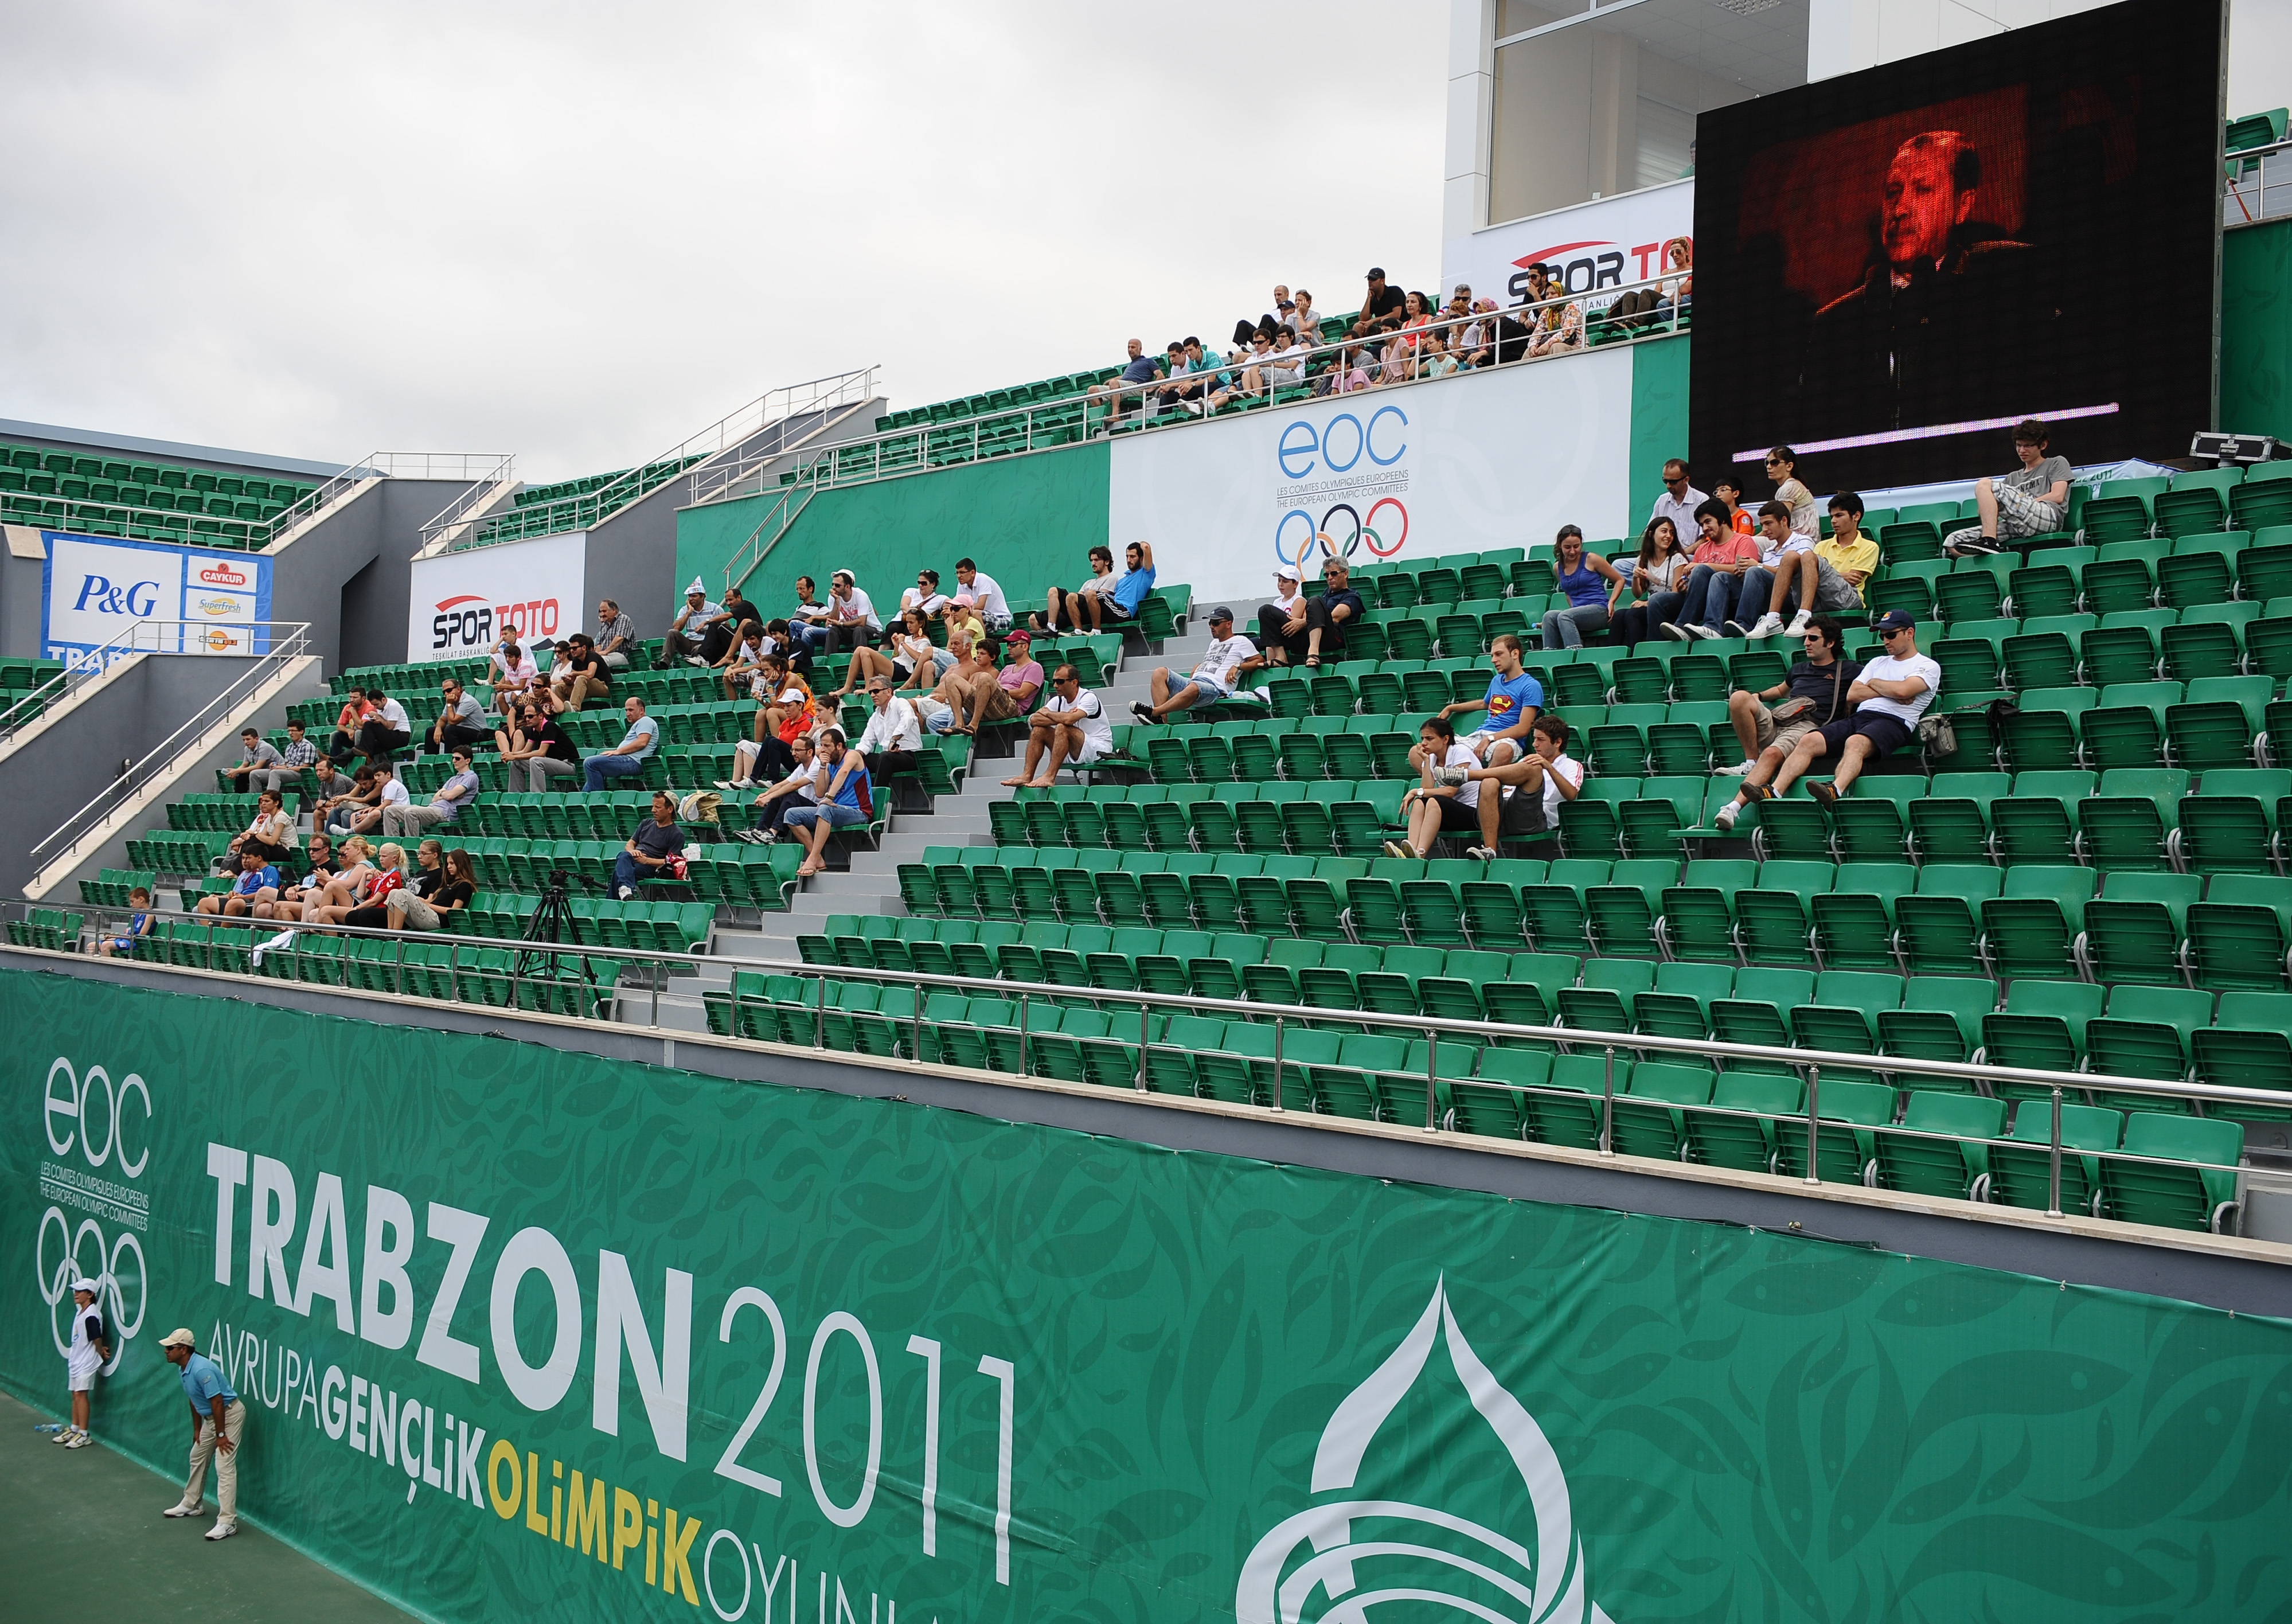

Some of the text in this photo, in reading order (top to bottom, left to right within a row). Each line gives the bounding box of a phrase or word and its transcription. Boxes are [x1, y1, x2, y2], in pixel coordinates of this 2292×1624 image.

[1277, 469, 1408, 497] LES COMITES OLYMPIQUES EUROPEENS
[1277, 483, 1408, 509] THE EUROPEAN OLYMPIC COMMITTEES
[72, 575, 161, 617] P&G
[203, 572, 243, 584] ÇAYKUR
[199, 599, 241, 612] SuperFresh
[433, 598, 559, 649] SPOR TOTO
[432, 645, 491, 660] TEŞKİLAT BAŞKANLIĞ
[41, 1161, 149, 1209] LES COMITES OLYMPIQUES EUROPEENS
[40, 1182, 148, 1232] THE EUROPEAN OLYMPIC COMMITTEES
[207, 1142, 1014, 1586] TRABZON 2011
[209, 1318, 319, 1428] AVRUPA
